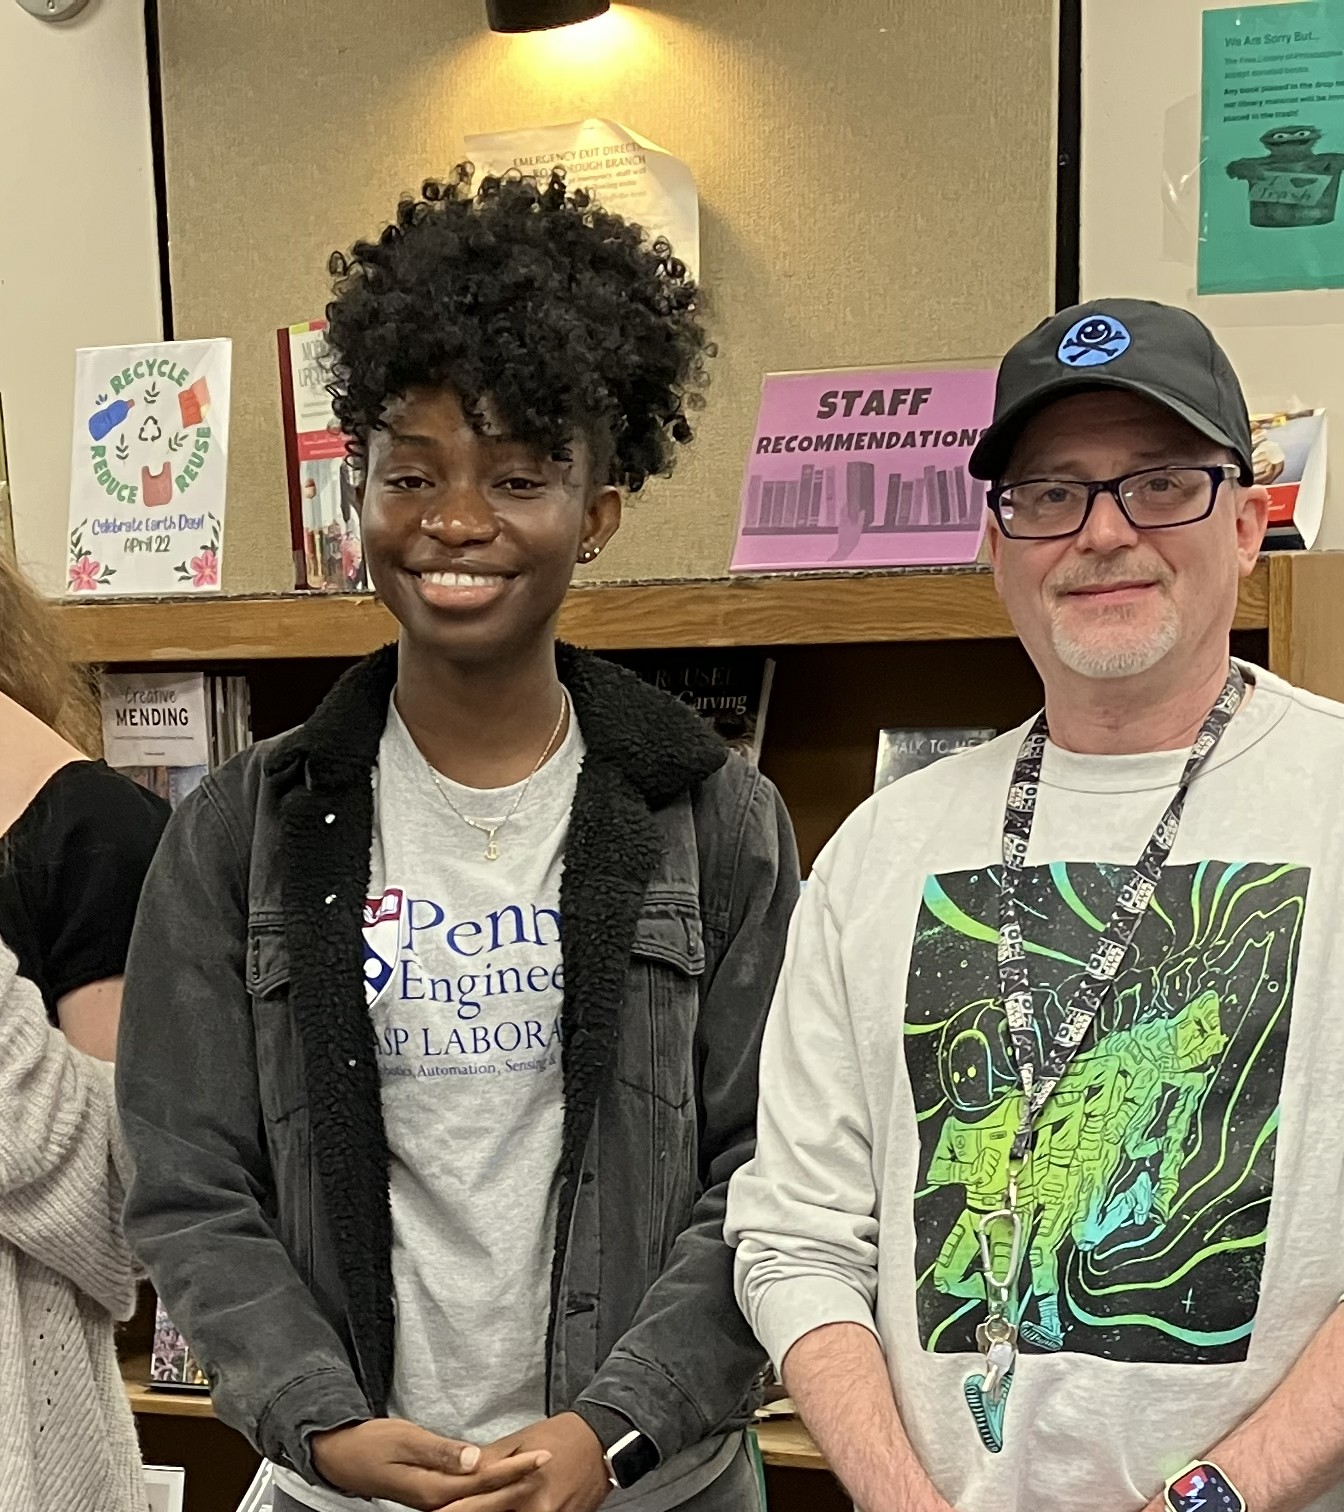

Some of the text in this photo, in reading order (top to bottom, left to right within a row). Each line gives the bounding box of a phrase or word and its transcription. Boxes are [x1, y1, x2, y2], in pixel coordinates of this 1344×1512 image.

[513, 150, 576, 167] EMERGENCY
[579, 147, 600, 159] EXIT
[110, 359, 189, 395] RECYCLE
[817, 387, 932, 420] STAFF
[175, 427, 211, 493] REUSE
[90, 445, 138, 504] REDUCE
[92, 517, 144, 535] Celebrate
[145, 516, 176, 532] Earth
[155, 534, 170, 552] 22
[125, 686, 176, 704] Creative
[115, 707, 189, 727] MENDING
[930, 739, 949, 754] TO
[402, 898, 563, 957] Penn
[416, 1063, 501, 1078] Automation,
[505, 1057, 548, 1073] Sensing
